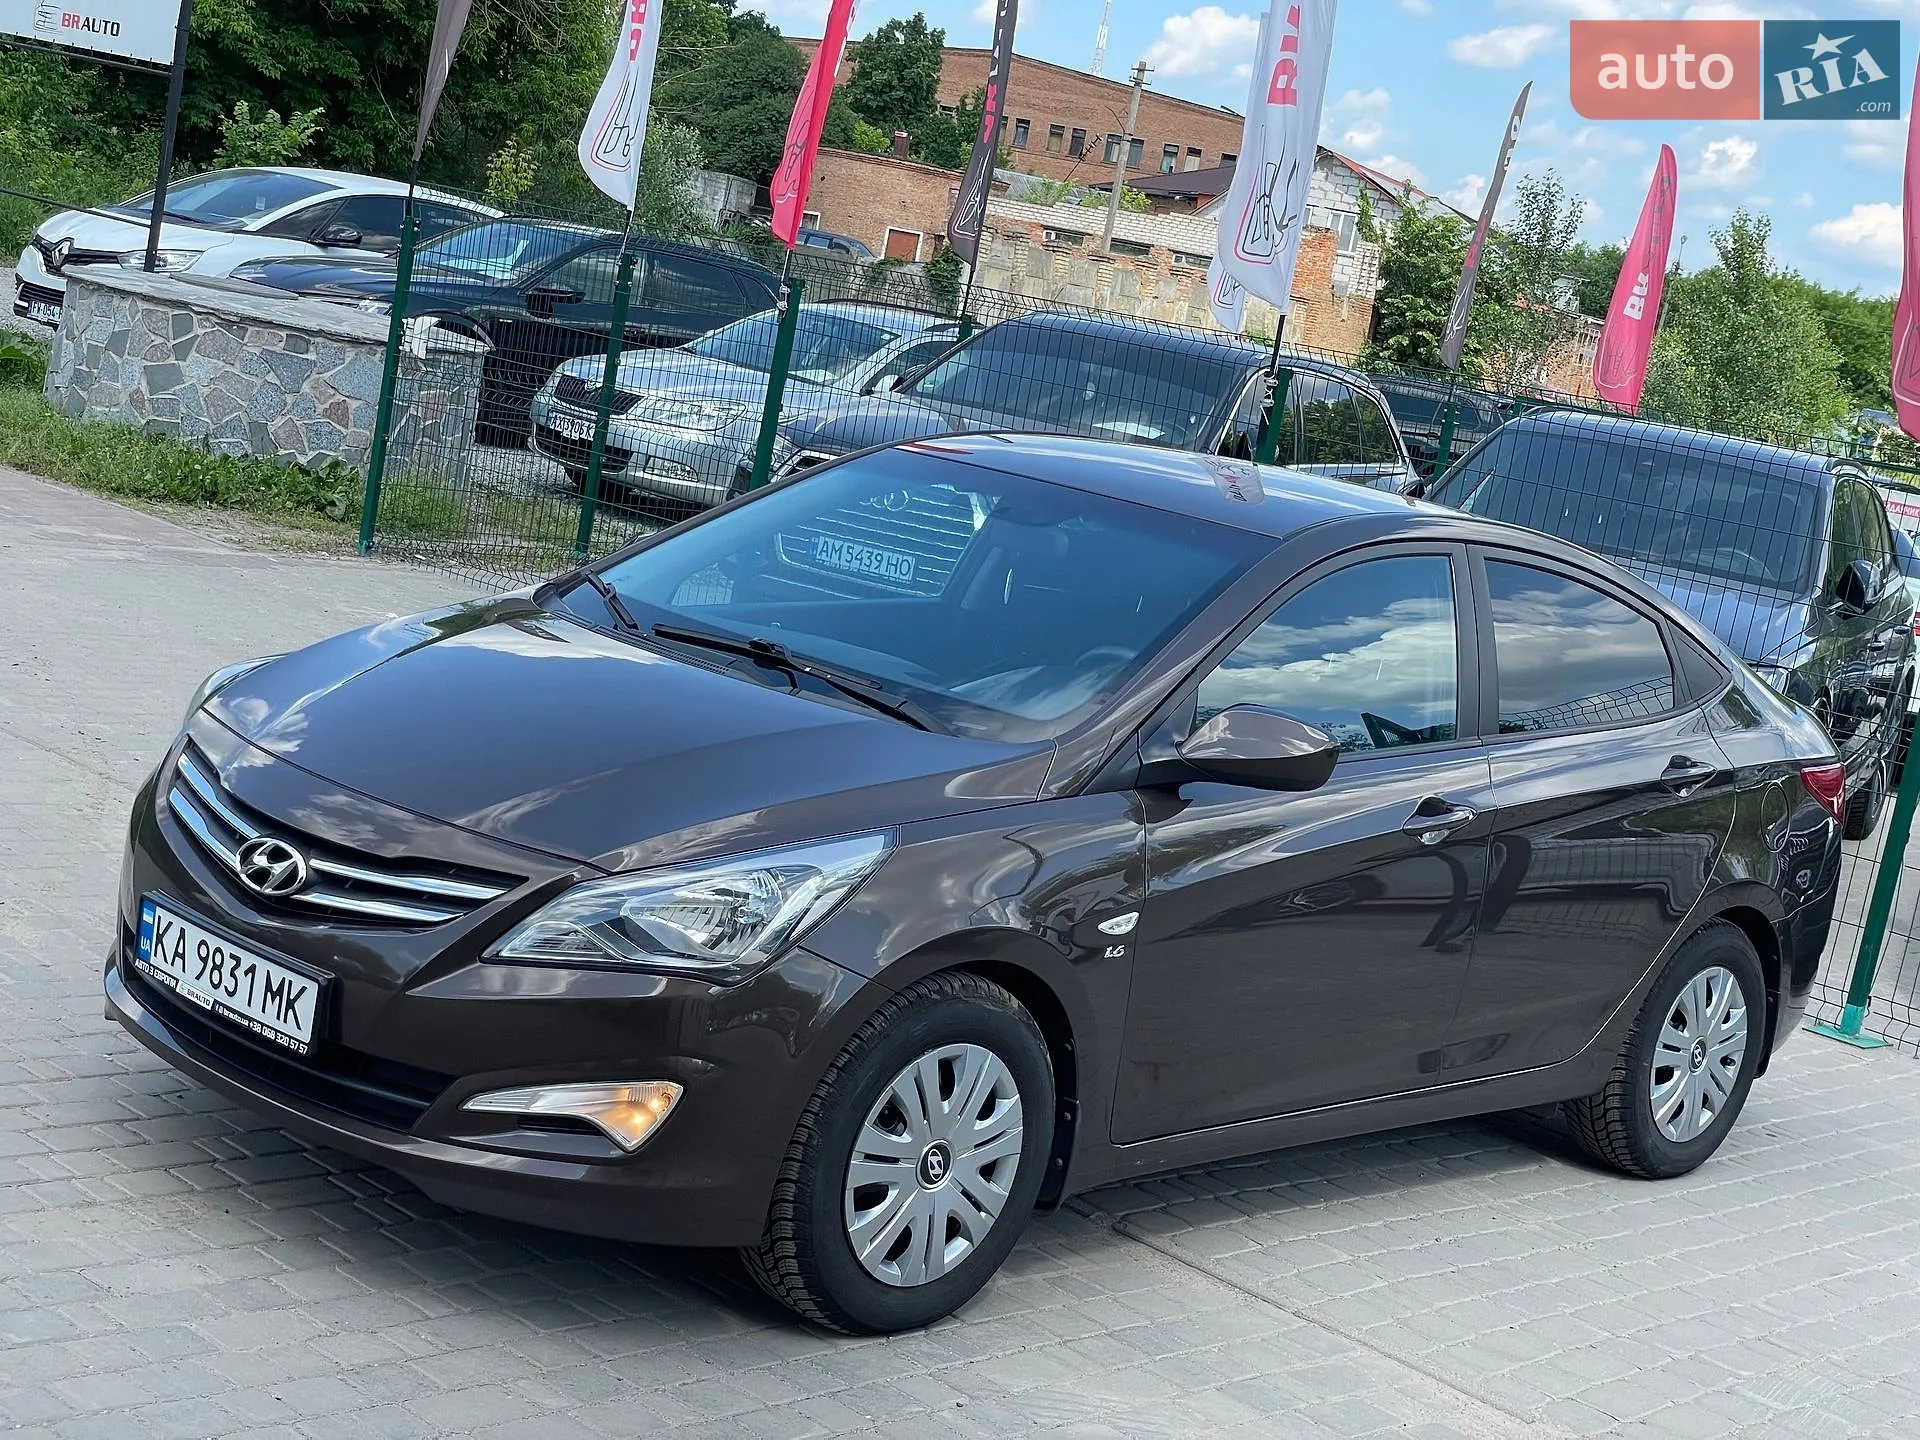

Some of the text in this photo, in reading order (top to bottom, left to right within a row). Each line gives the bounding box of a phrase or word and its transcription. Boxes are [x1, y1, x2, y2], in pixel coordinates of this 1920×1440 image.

[61, 12, 121, 37] BRAUTO
[818, 540, 844, 561] AM
[845, 545, 884, 571] 5439
[885, 554, 911, 577] HO
[140, 935, 151, 952] UA
[153, 914, 308, 1032] KA 9831 MK
[262, 1026, 276, 1041] 068
[275, 1032, 289, 1046] 320
[289, 1038, 299, 1051] 57
[298, 1044, 309, 1055] 57
